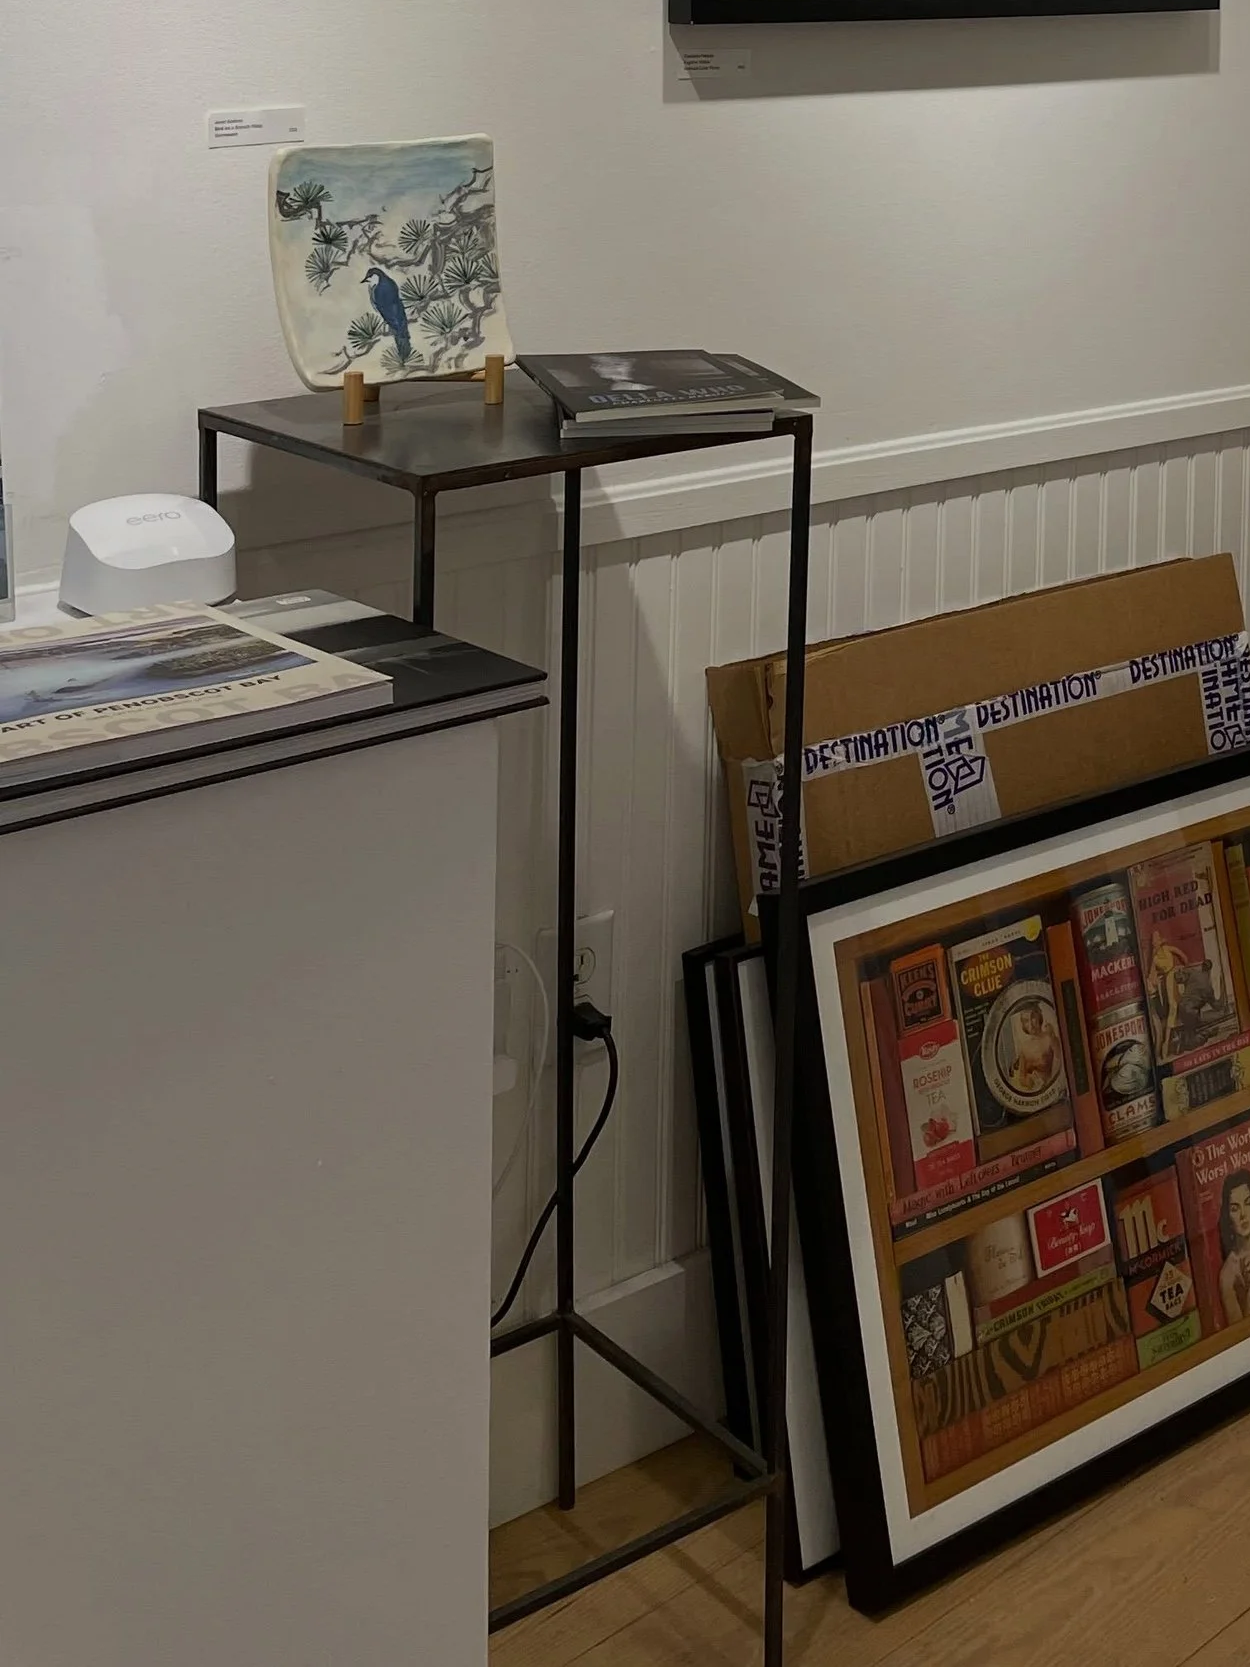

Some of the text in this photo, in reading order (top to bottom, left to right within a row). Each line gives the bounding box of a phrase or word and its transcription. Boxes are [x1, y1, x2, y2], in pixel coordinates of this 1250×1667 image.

[126, 511, 181, 526] eero
[1, 719, 46, 734] ART
[54, 710, 84, 722] OF
[93, 684, 233, 714] PENOBSCOT
[241, 675, 282, 688] BAY
[804, 635, 1235, 774] DESTINATION DESTINATION DESTINATION
[1139, 880, 1199, 911] HIGH RED
[1153, 892, 1213, 924] FOR DEAD
[961, 953, 1013, 985] CRIMSON
[974, 974, 1003, 997] CLUE
[913, 1065, 952, 1089] ROSEHIP
[926, 1090, 947, 1106] TEA
[1108, 1096, 1156, 1125] CLAMS
[1205, 1143, 1226, 1161] The
[1196, 1161, 1228, 1186] Worst
[1160, 1283, 1184, 1304] TEA
[993, 1303, 1035, 1332] CRIMSON
